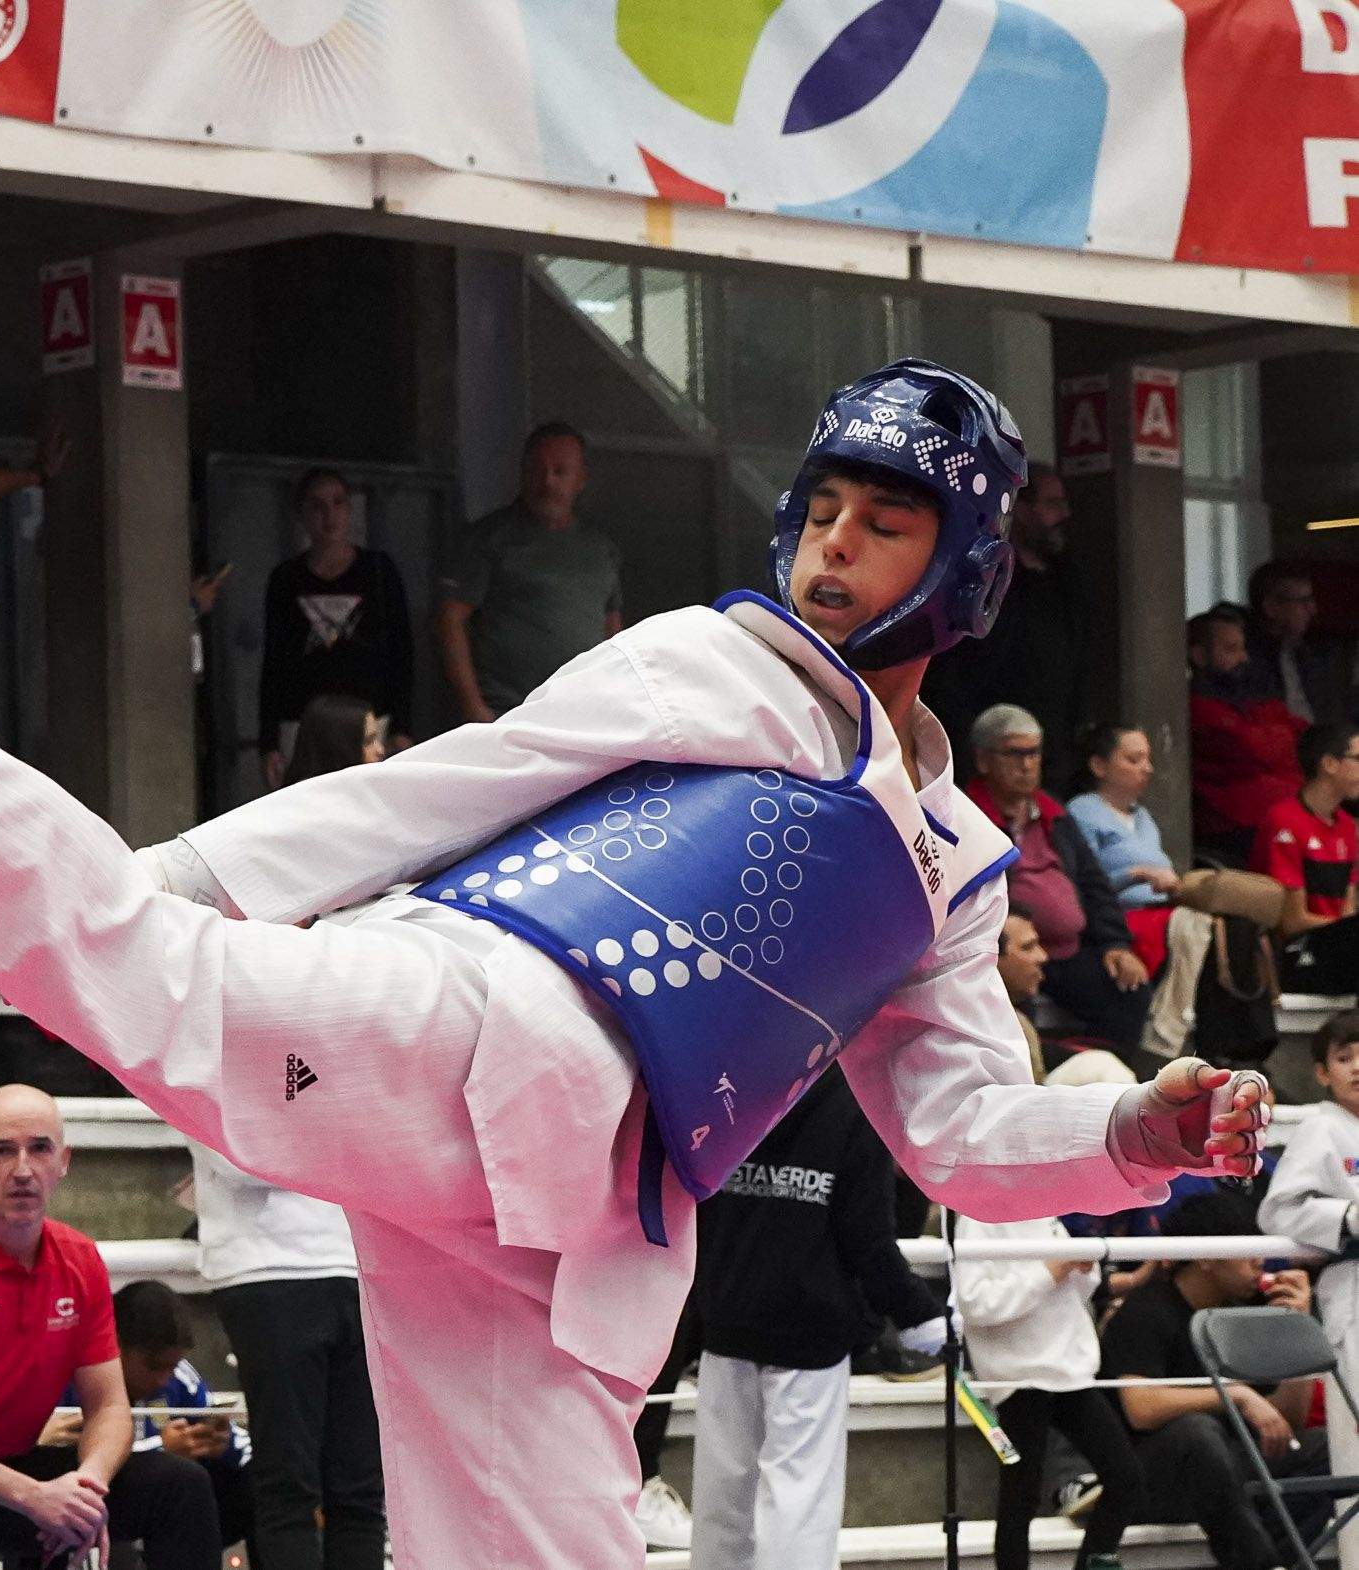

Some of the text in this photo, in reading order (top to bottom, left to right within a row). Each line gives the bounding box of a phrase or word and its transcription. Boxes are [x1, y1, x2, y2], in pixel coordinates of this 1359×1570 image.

[50, 285, 83, 340] A
[131, 302, 171, 358] A
[844, 418, 907, 448] Daedo
[1141, 390, 1172, 439] A
[913, 829, 940, 895] Daedo
[286, 1053, 297, 1101] adidas
